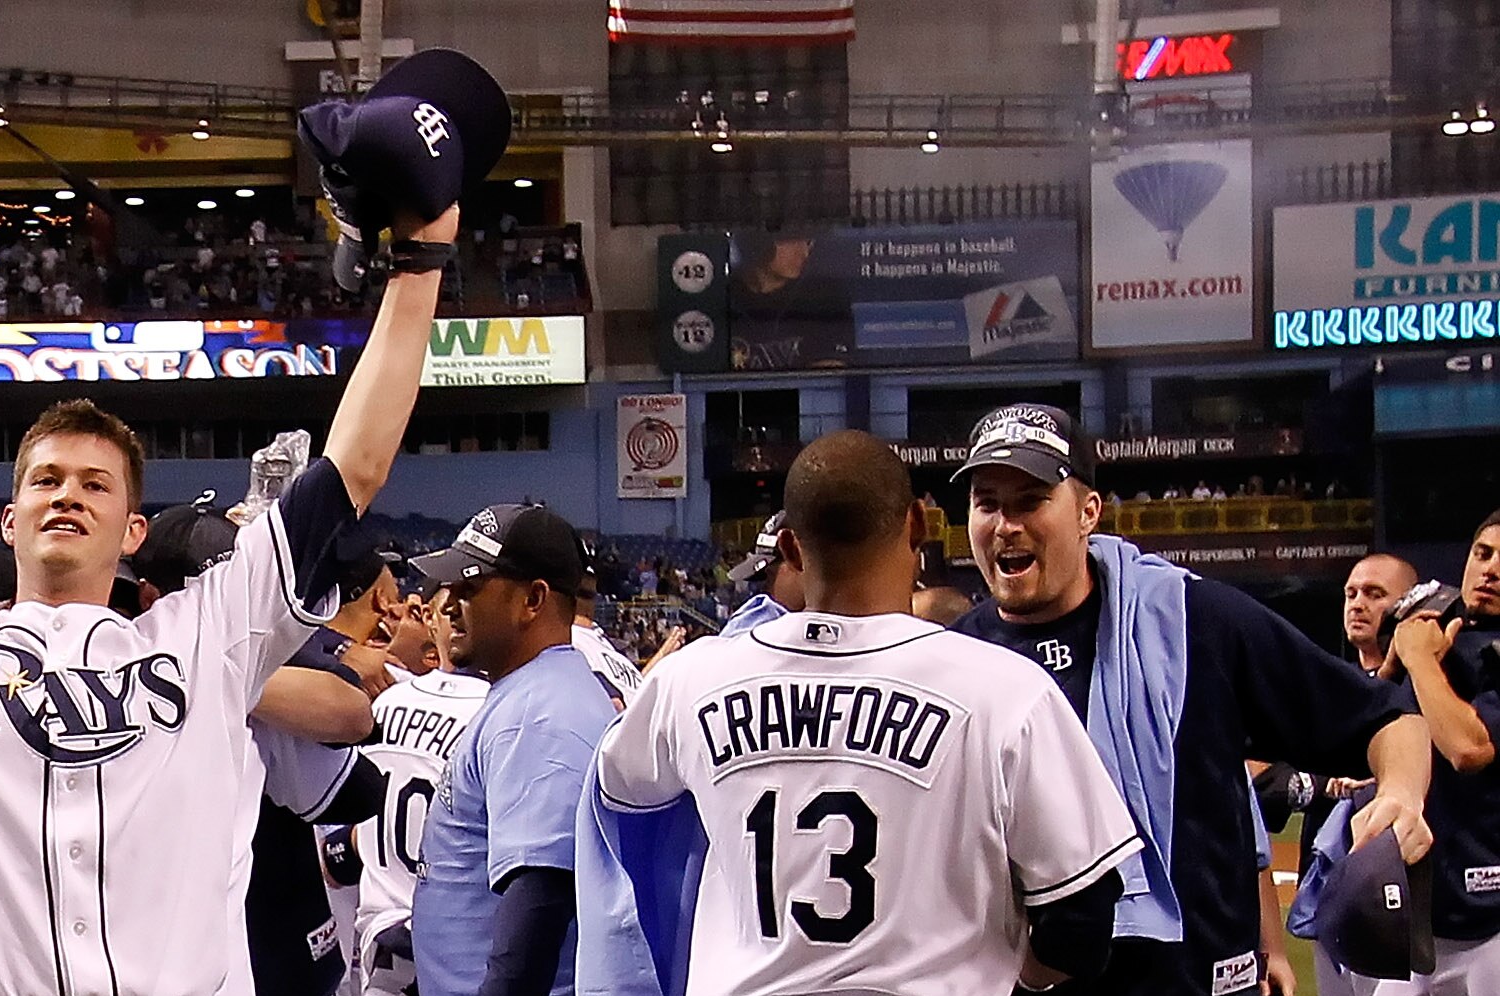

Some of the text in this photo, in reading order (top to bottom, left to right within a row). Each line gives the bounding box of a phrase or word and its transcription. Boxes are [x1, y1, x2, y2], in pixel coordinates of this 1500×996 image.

[1097, 274, 1243, 301] remax.com
[430, 318, 550, 356] WM
[432, 371, 485, 386] Think
[1095, 436, 1235, 461] Captain Morgan DECK
[1036, 639, 1073, 671] TB
[697, 683, 951, 770] CRAWFORD
[372, 770, 437, 875] 10
[744, 788, 880, 944] 13
